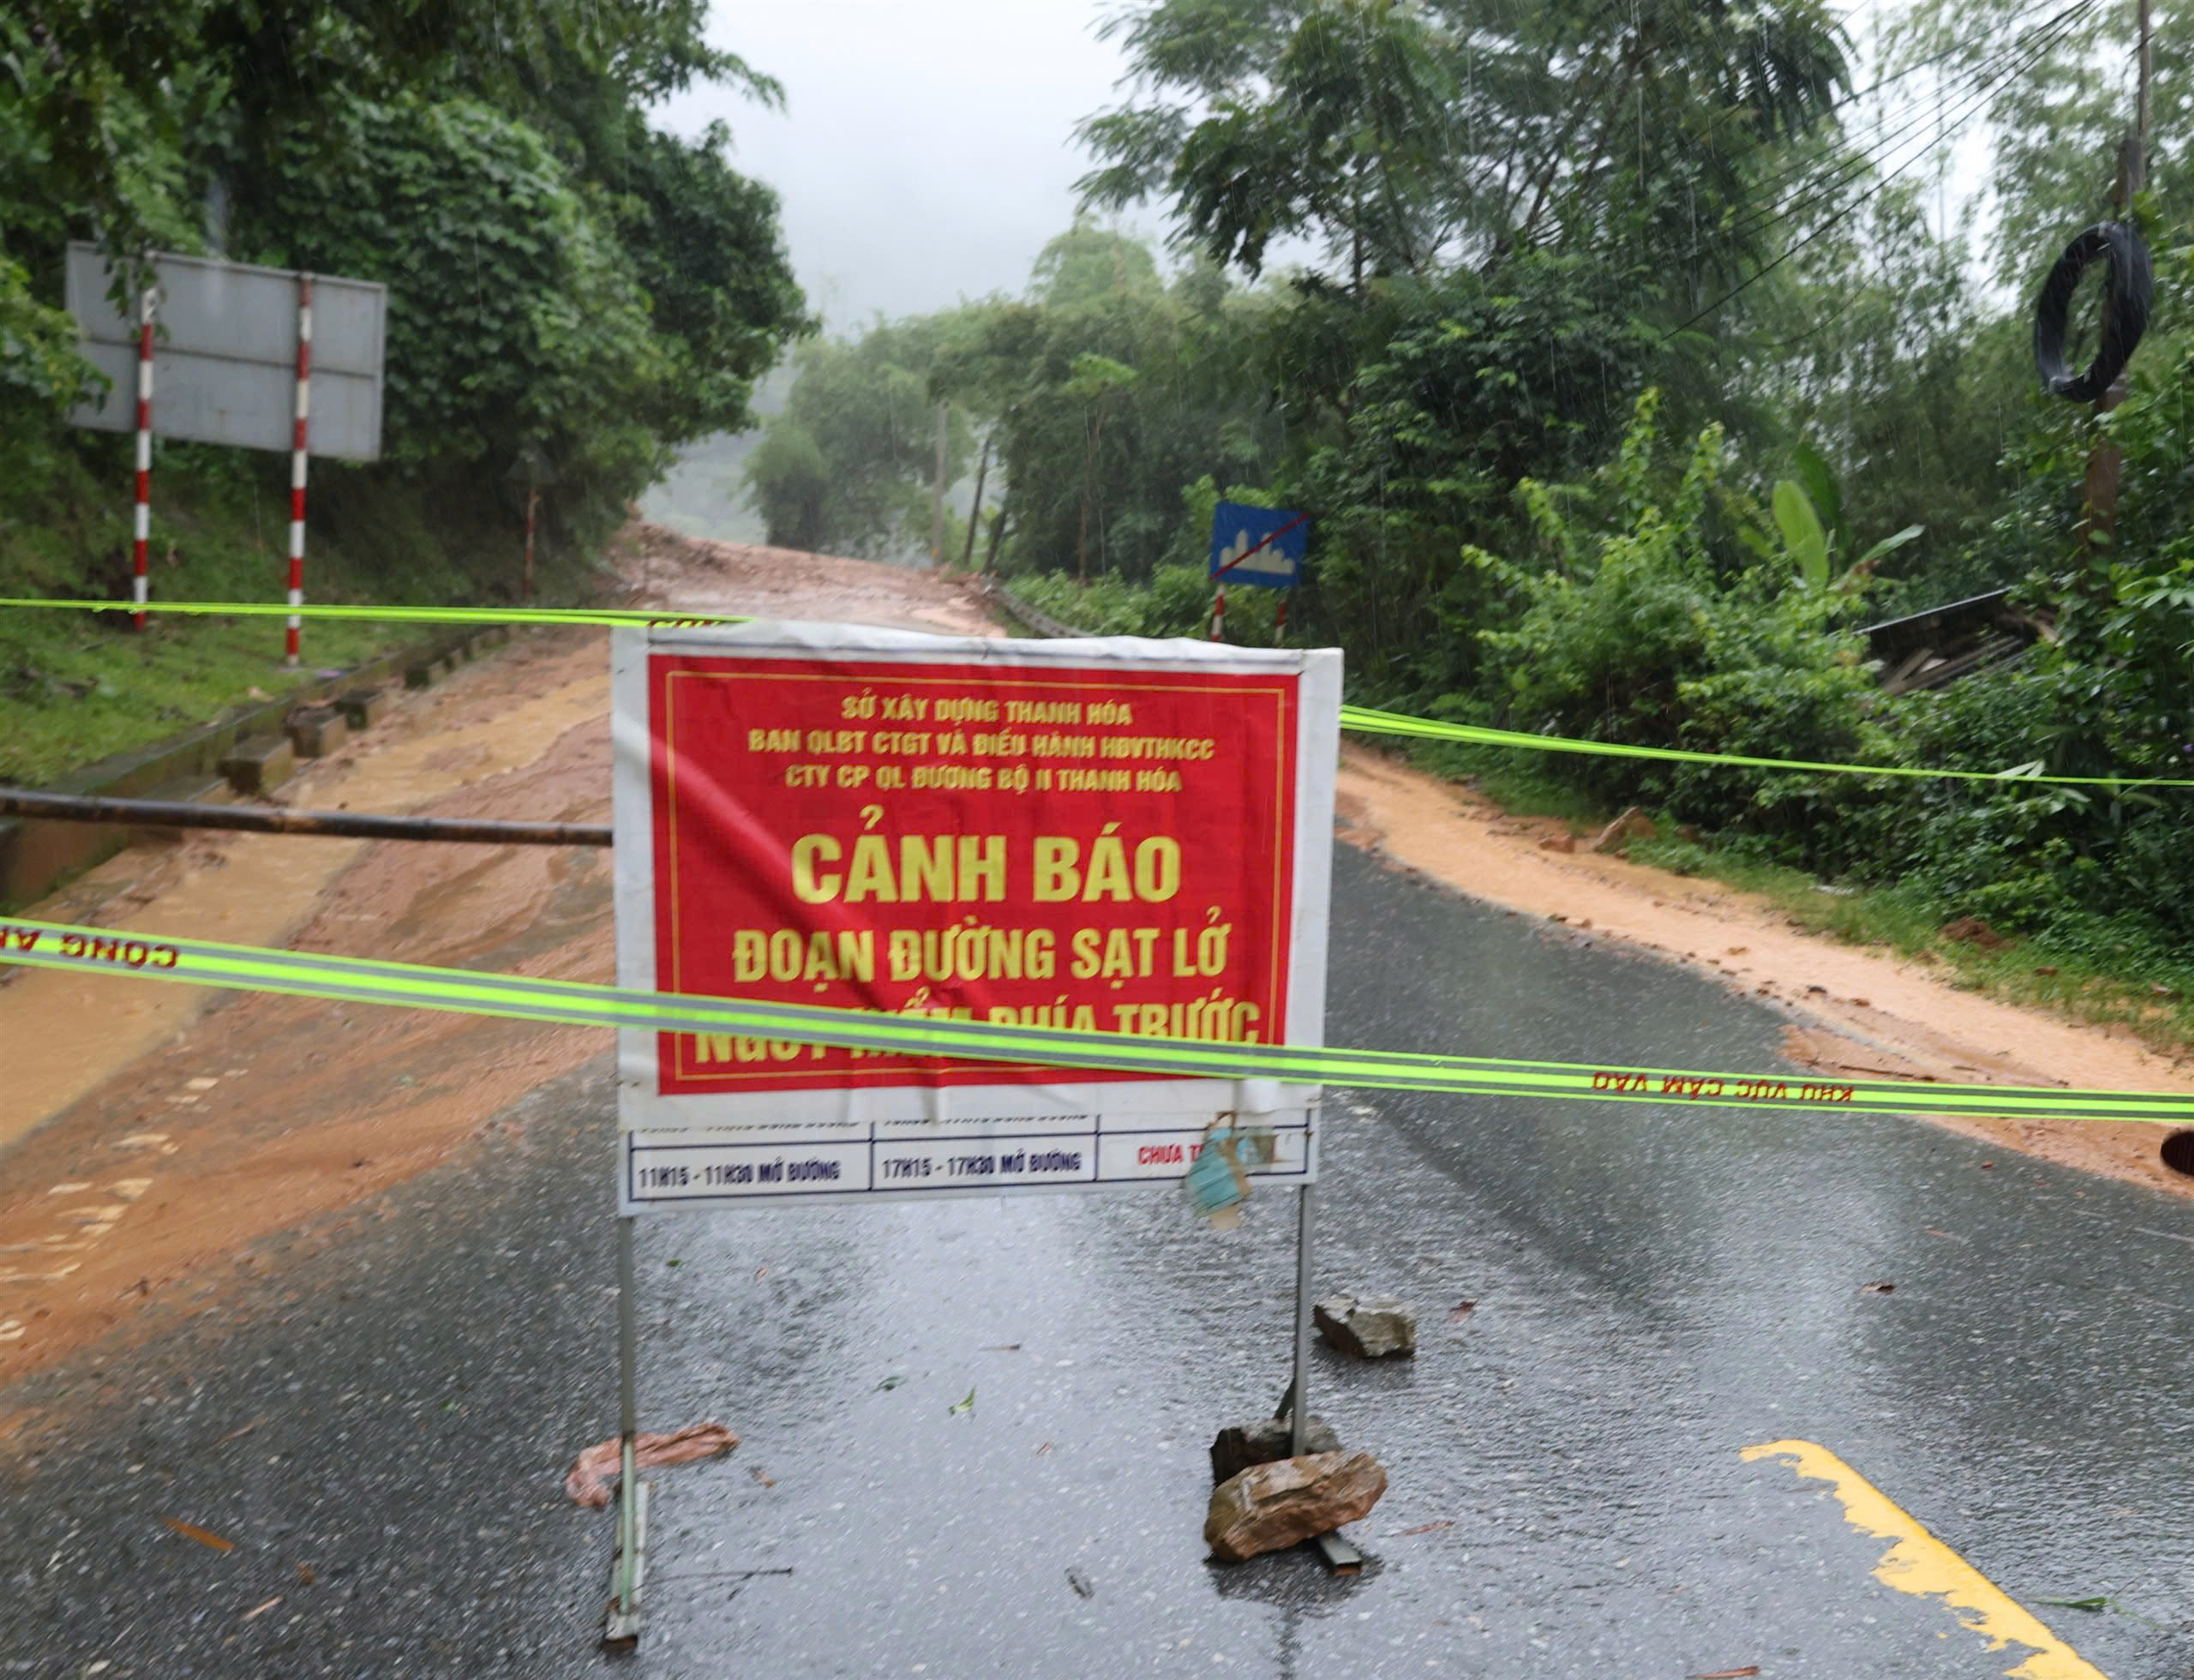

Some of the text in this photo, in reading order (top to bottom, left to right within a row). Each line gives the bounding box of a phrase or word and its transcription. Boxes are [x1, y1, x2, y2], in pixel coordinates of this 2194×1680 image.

[841, 687, 1133, 726] SỞ XÂY DỰNG THANH HÓA
[748, 729, 801, 753] BAN
[806, 729, 867, 755] QLBT
[872, 730, 932, 754] CTGT
[936, 728, 967, 755] VÀ
[1031, 730, 1096, 758] HÀNH
[783, 764, 831, 788] CTY
[836, 764, 870, 788] CP
[875, 765, 906, 790] QL
[997, 763, 1030, 795] BỘ
[1056, 768, 1131, 791] THANH
[1136, 765, 1182, 793] HÓA
[791, 803, 1181, 904] CẢNH BÁO
[732, 905, 1232, 993] ĐOẠN ĐƯỜNG SẠT LỞ
[1112, 987, 1260, 1045] TRƯỚC
[1800, 1083, 1855, 1103] KHU
[882, 1157, 932, 1179] 17H15
[1136, 1143, 1184, 1165] CHƯA
[638, 1166, 689, 1188] 11H15
